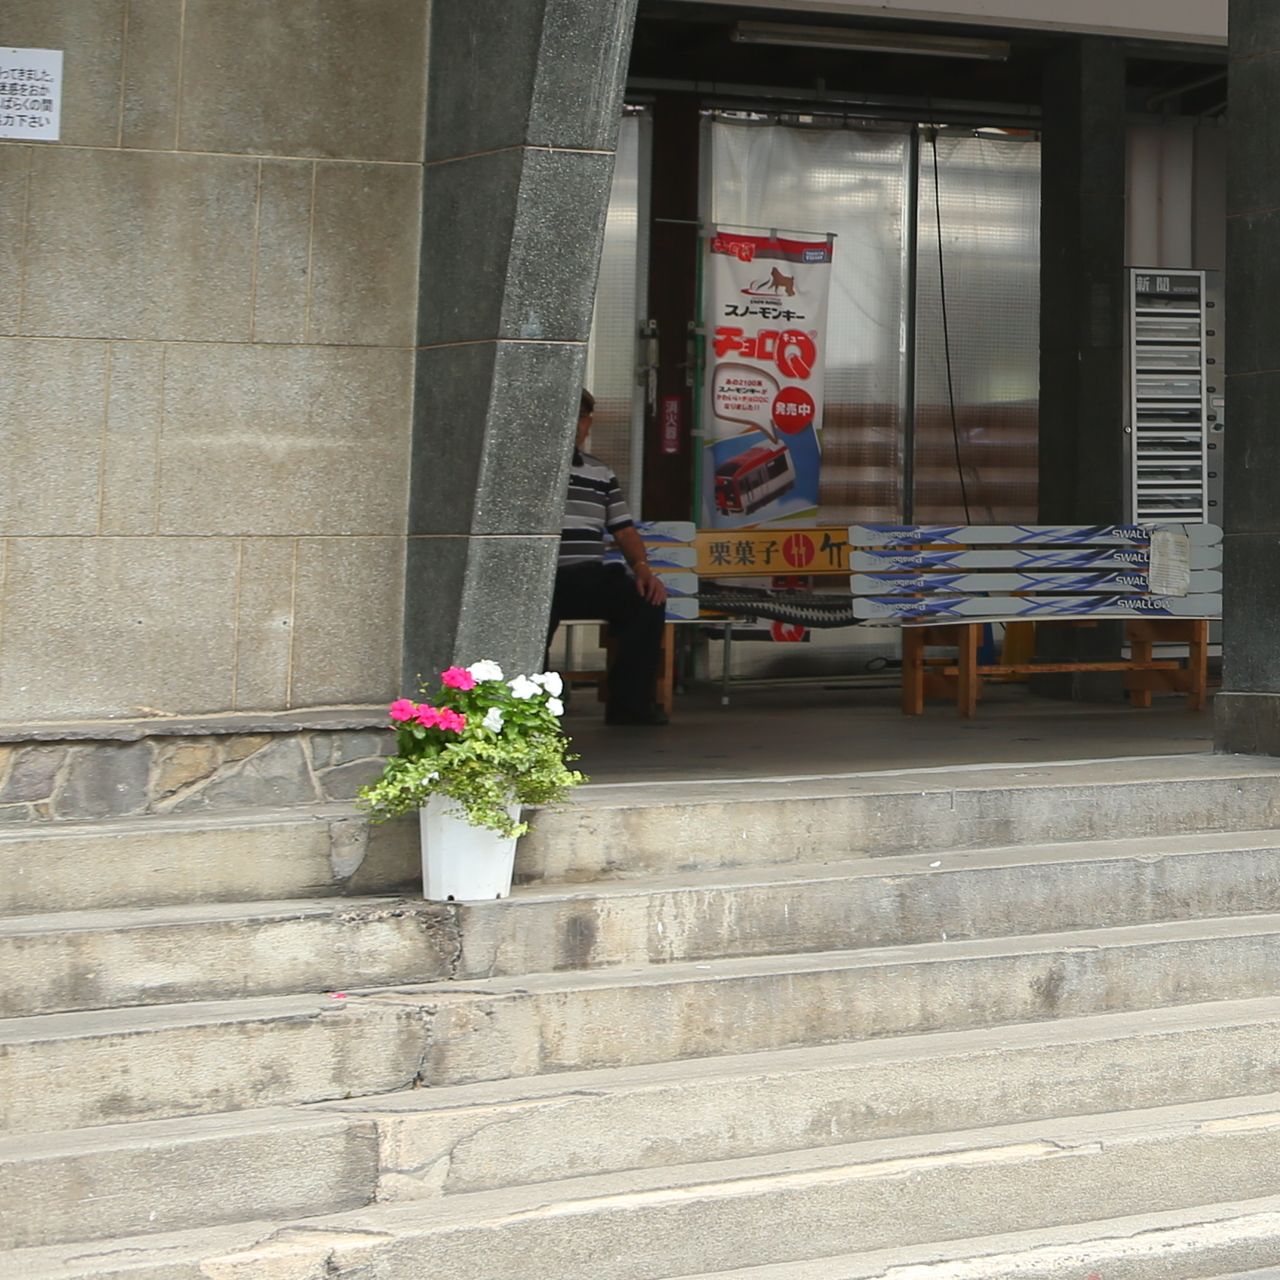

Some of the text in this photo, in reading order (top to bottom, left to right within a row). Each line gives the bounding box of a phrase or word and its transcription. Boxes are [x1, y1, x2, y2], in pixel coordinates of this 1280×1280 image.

[724, 304, 806, 322] スノーモンキー
[712, 326, 817, 380] チョロQ
[775, 401, 811, 417] 発売中
[1112, 528, 1150, 540] SWALL
[709, 539, 779, 566] 栗菓子
[1113, 552, 1150, 563] SWALL
[1115, 575, 1149, 586] SWAL
[1117, 599, 1171, 609] SWALLOW
